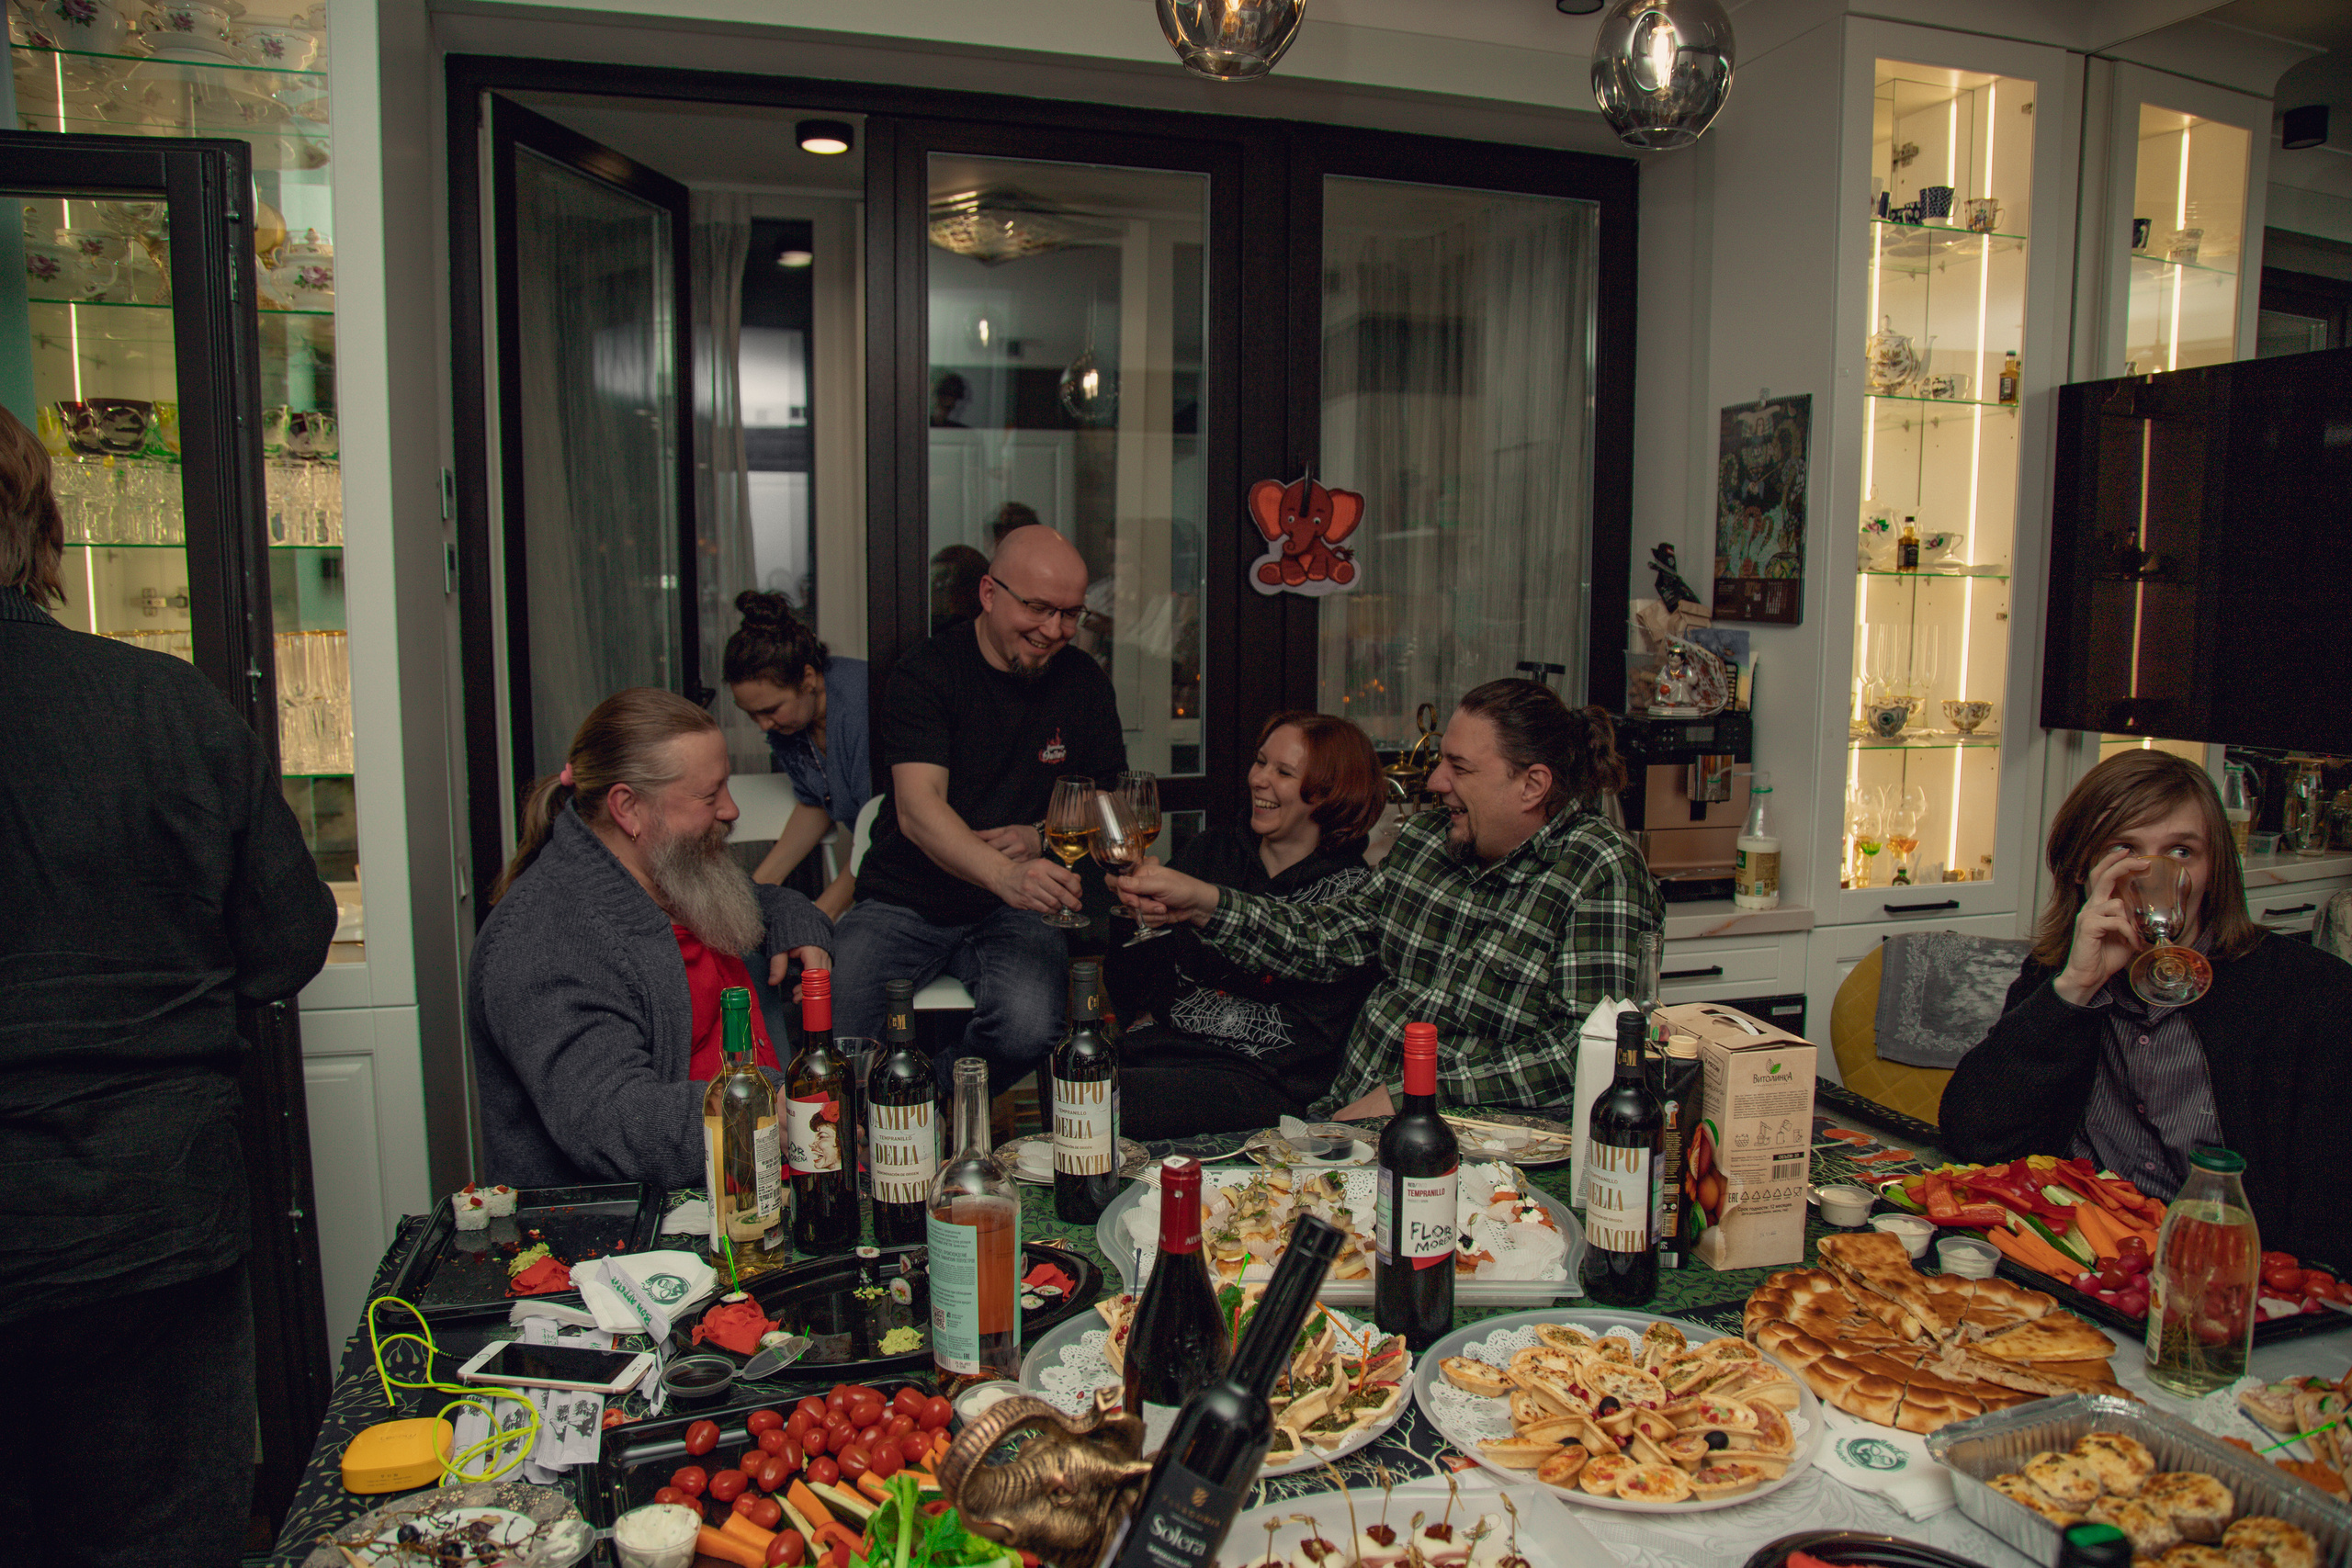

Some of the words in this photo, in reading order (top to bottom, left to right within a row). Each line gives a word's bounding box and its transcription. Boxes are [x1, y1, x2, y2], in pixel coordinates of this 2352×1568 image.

[1054, 1079, 1104, 1105] AMPO
[876, 1143, 919, 1166] DELIA
[881, 1179, 930, 1203] MANCH
[1408, 1188, 1445, 1198] TEMPRANILLO
[1410, 1221, 1453, 1241] FLOR
[1415, 1233, 1454, 1253] MOREN
[610, 1276, 637, 1305] appetit
[637, 1303, 653, 1327] Bon
[1149, 1514, 1206, 1556] Solera
